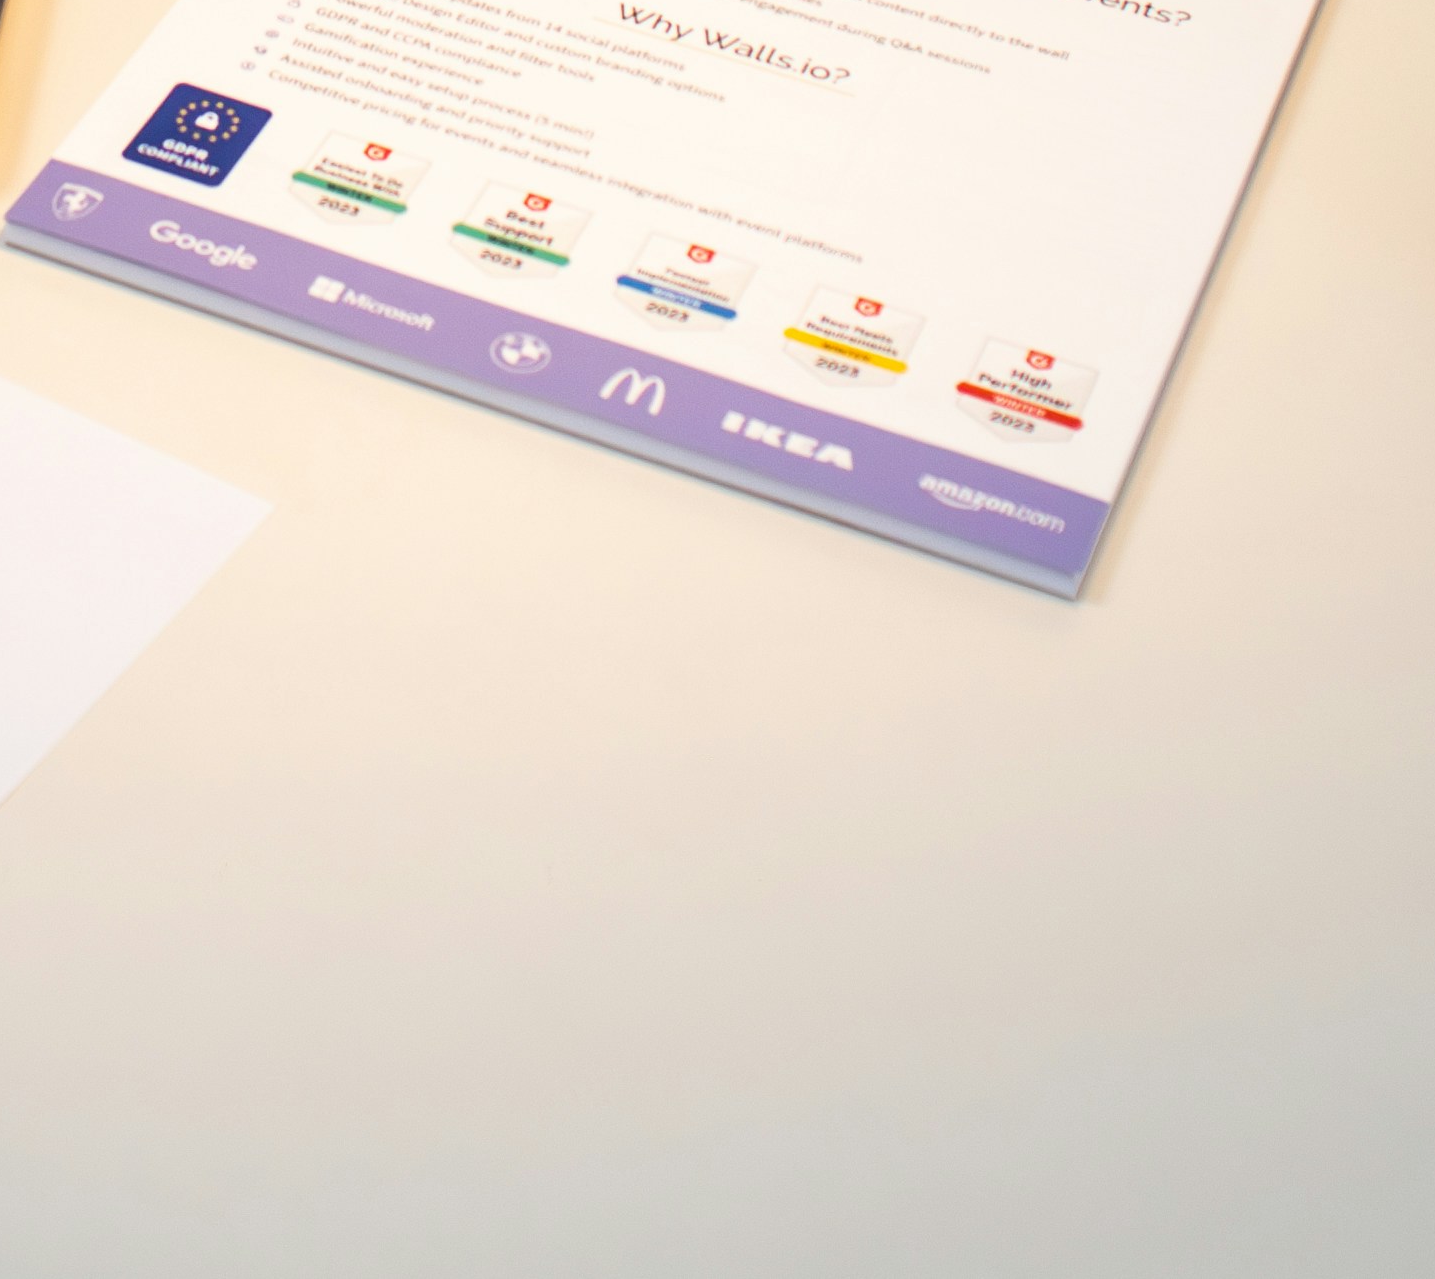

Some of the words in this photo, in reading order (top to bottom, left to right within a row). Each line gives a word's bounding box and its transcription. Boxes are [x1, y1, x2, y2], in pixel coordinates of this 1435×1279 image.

[619, 2, 692, 41] Why
[704, 28, 850, 80] Walls.io?
[162, 138, 208, 161] GDPR
[149, 219, 257, 270] Google
[341, 288, 435, 331] Microsoft
[721, 410, 852, 470] IKEA
